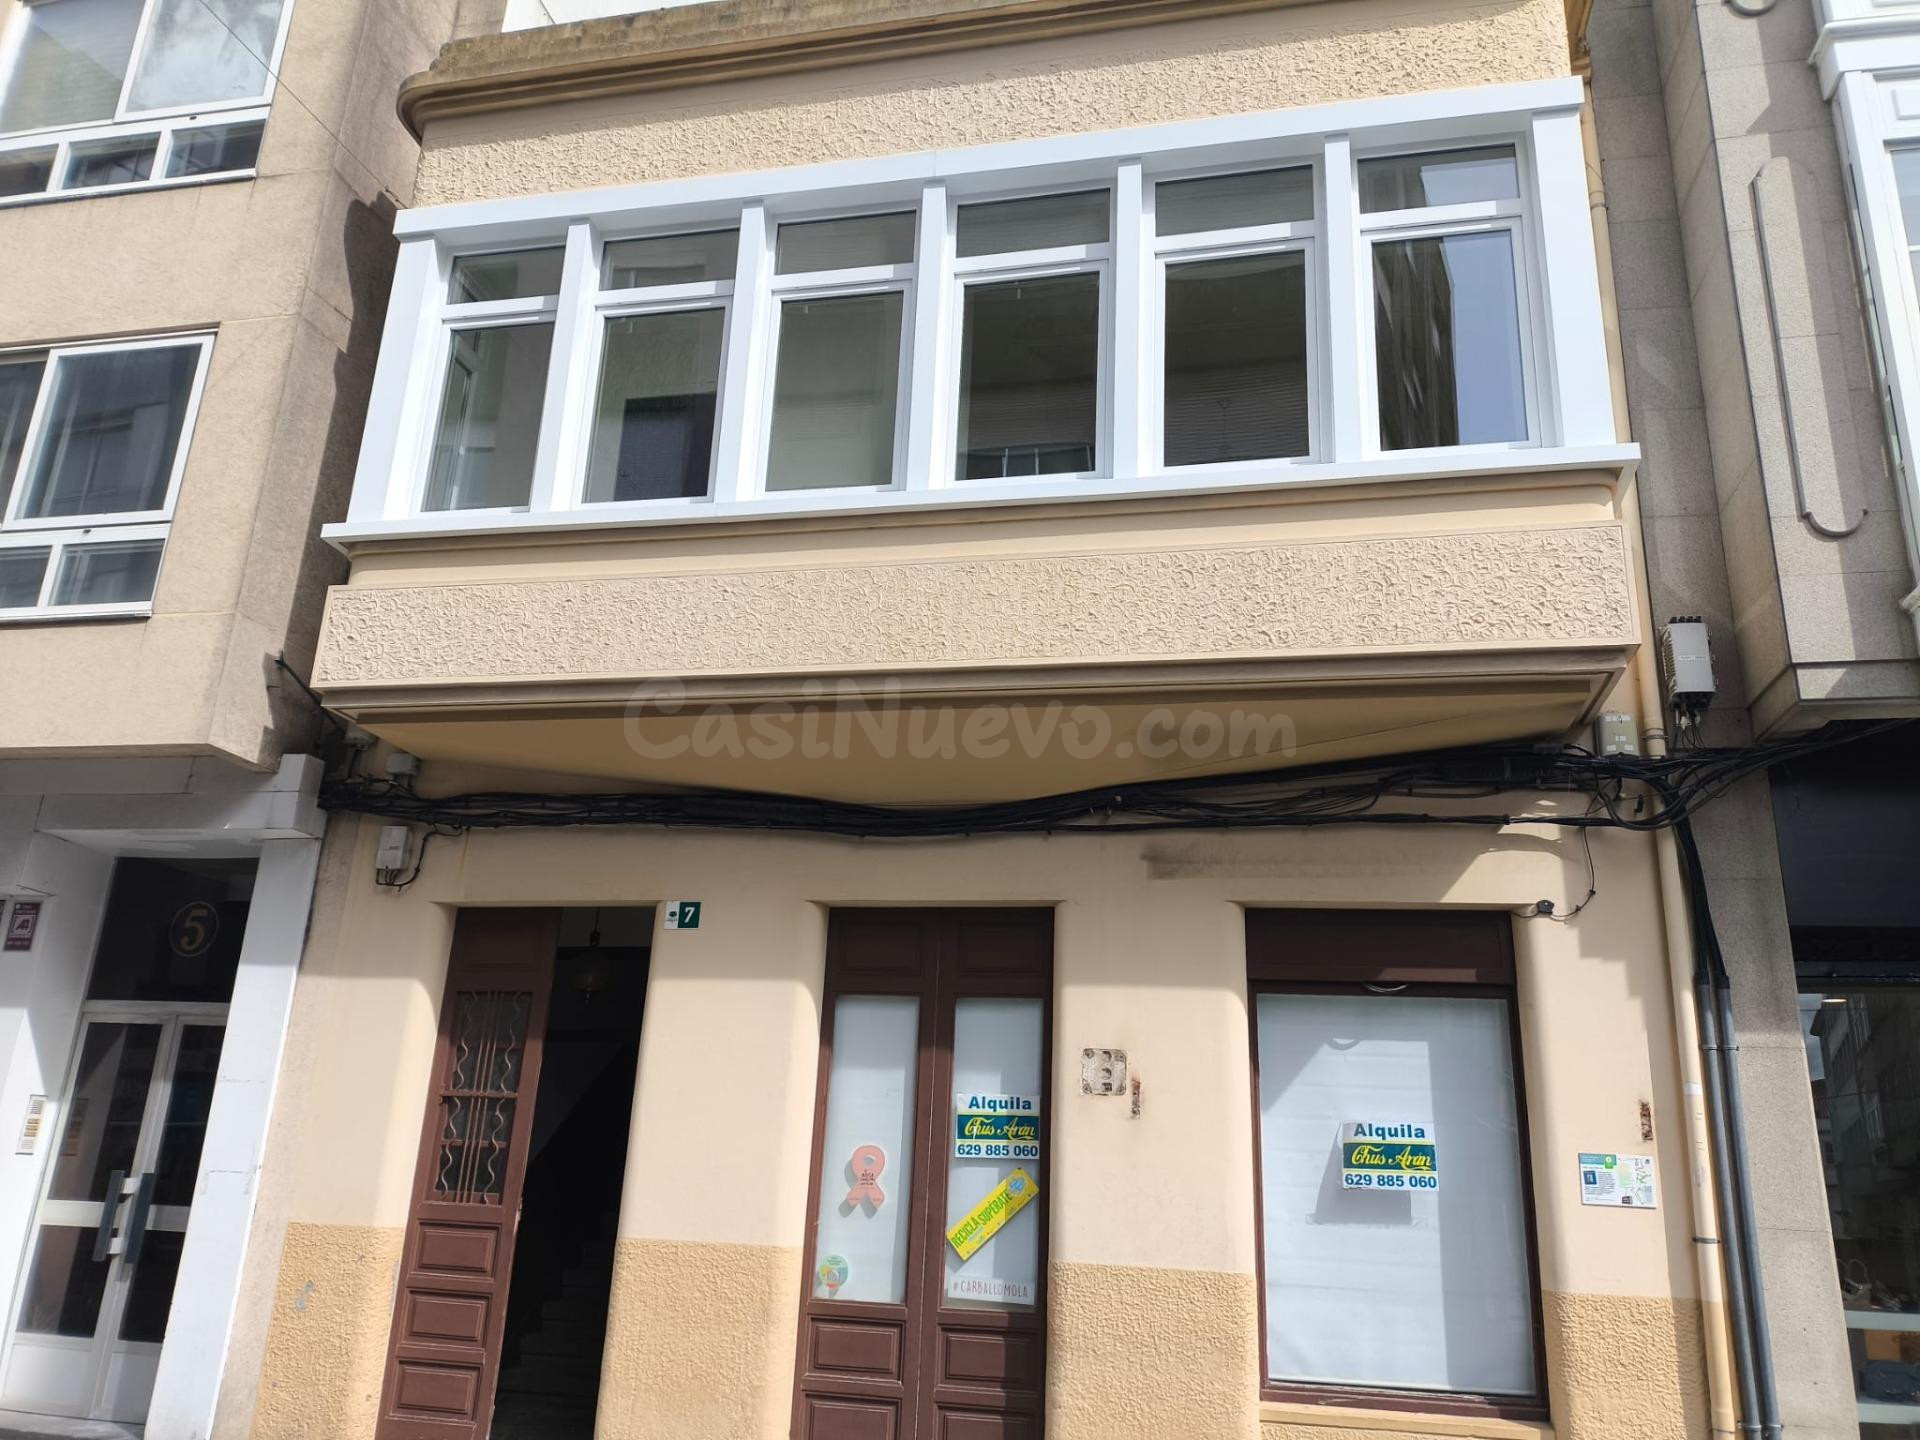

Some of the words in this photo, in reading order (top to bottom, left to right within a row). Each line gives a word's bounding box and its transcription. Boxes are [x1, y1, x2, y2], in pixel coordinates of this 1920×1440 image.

[684, 906, 696, 923] 7
[180, 909, 208, 951] 5
[968, 1096, 1032, 1112] Alquila
[964, 1116, 995, 1139] Chus
[1353, 1123, 1426, 1141] Alquila
[957, 1144, 981, 1155] 629
[985, 1145, 1010, 1156] 885
[1013, 1145, 1038, 1157] 060
[1351, 1145, 1386, 1165] Chus
[1344, 1173, 1372, 1186] 629
[1376, 1174, 1405, 1187] 885
[1408, 1175, 1437, 1189] 060
[950, 1215, 982, 1249] RECICLA
